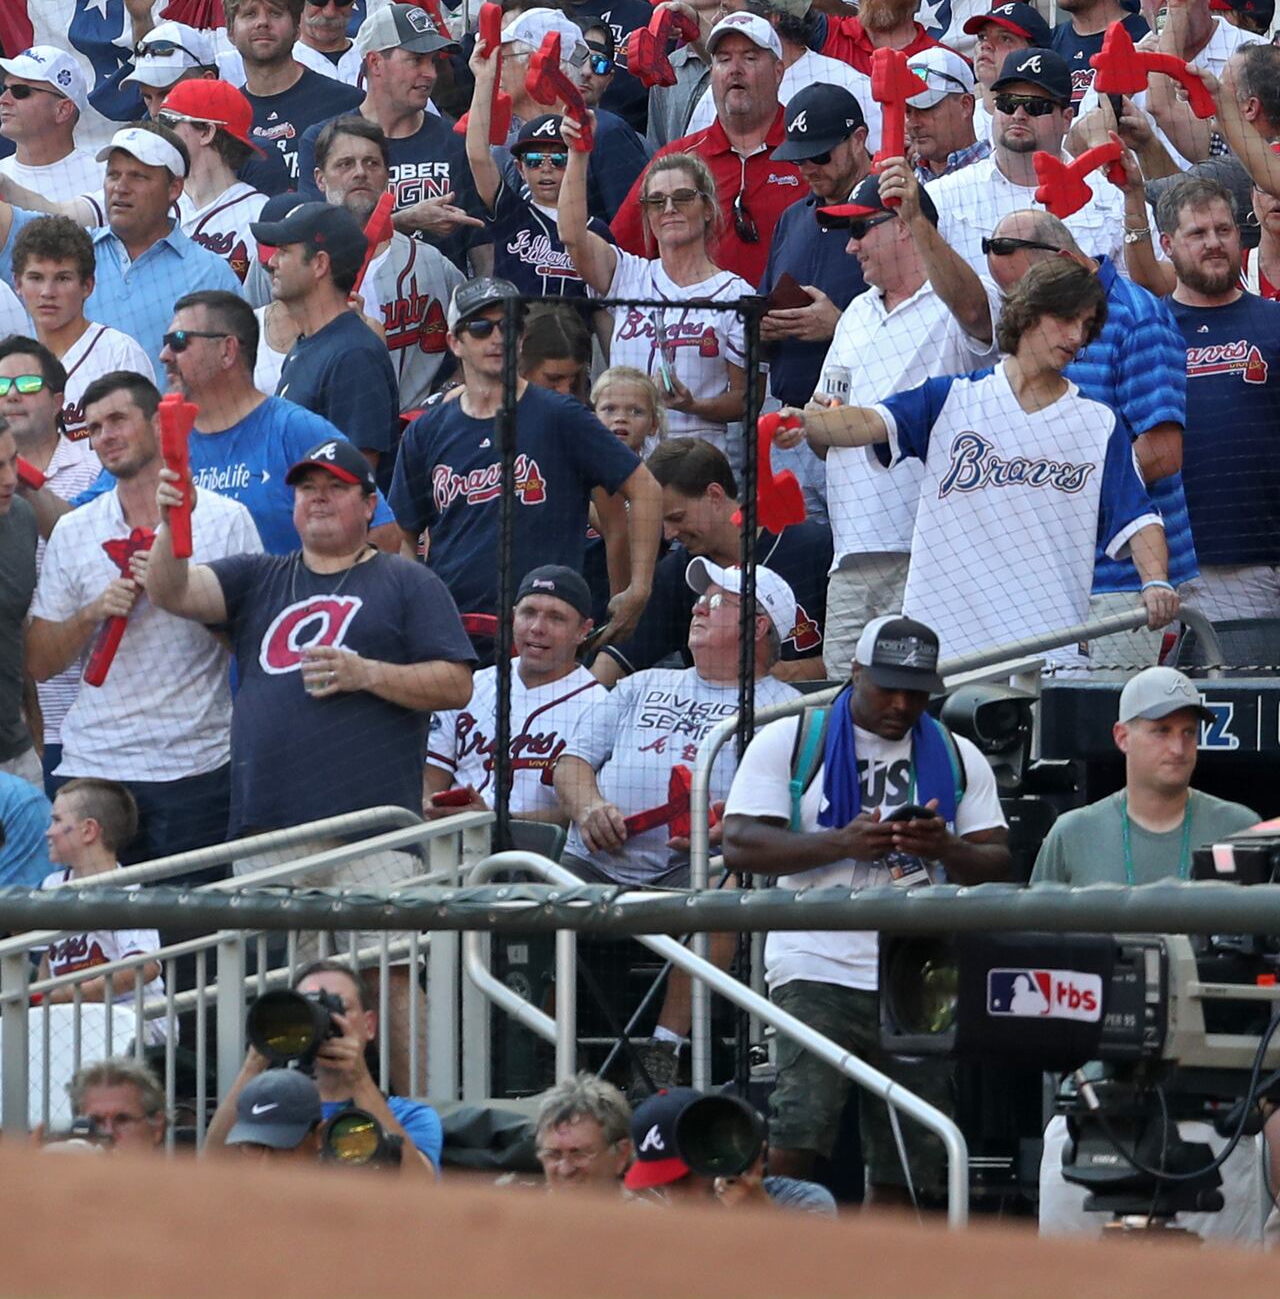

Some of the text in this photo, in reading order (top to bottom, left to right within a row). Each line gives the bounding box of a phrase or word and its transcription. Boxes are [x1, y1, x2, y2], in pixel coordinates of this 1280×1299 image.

[1016, 55, 1042, 73] A
[533, 119, 556, 136] A
[788, 111, 808, 132] A
[389, 160, 450, 180] OBER
[389, 178, 450, 211] IGN
[506, 229, 574, 268] Atlan
[1186, 341, 1247, 365] aves
[826, 378, 849, 395] Lite
[311, 442, 337, 460] A
[940, 432, 1095, 499] Braves
[192, 468, 250, 490] eTribeLife
[433, 453, 527, 505] Bravs
[261, 595, 364, 675] a
[645, 690, 738, 716] DIVISIO
[1056, 977, 1098, 1011] tbs
[640, 1124, 665, 1151] A
